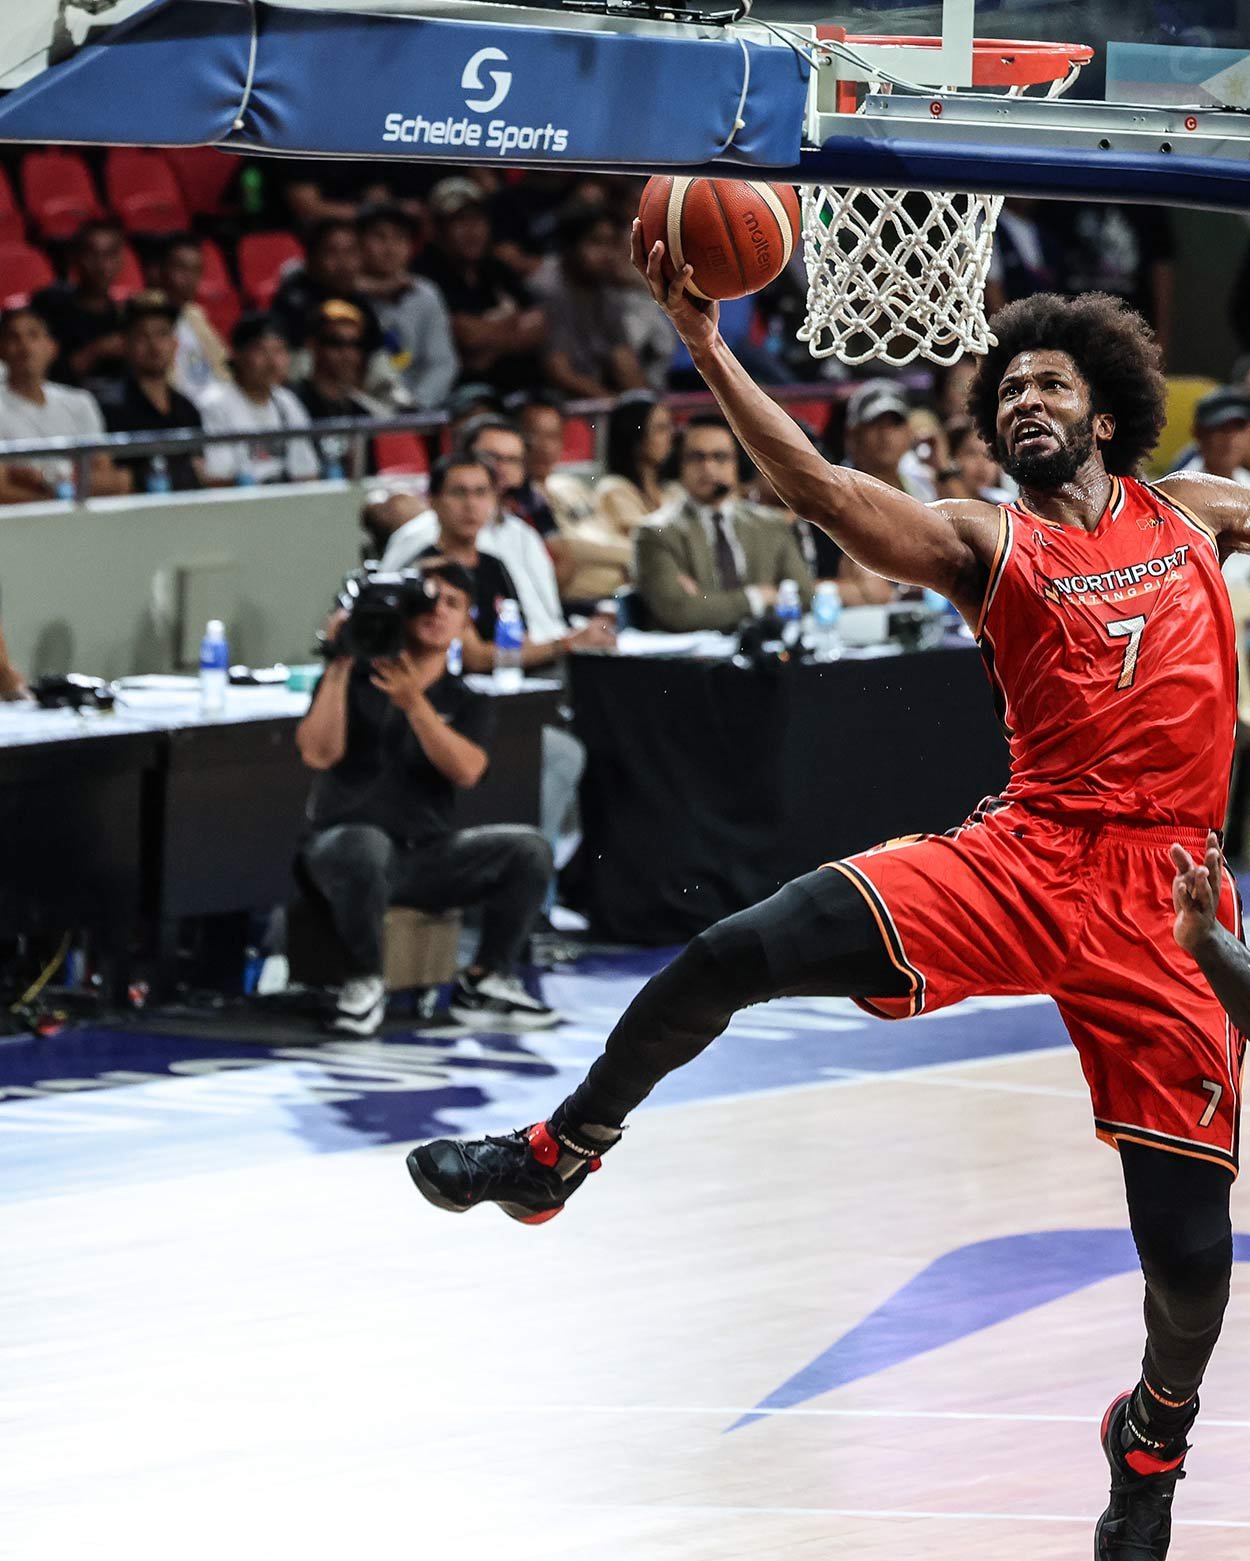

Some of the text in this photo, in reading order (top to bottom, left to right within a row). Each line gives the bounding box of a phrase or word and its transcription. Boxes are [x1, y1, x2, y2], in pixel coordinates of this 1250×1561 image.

[382, 113, 569, 156] Schelde Sports
[742, 210, 771, 270] molten
[1053, 544, 1189, 595] NORTHPORT
[1107, 613, 1146, 692] 7
[1198, 1079, 1223, 1128] 7
